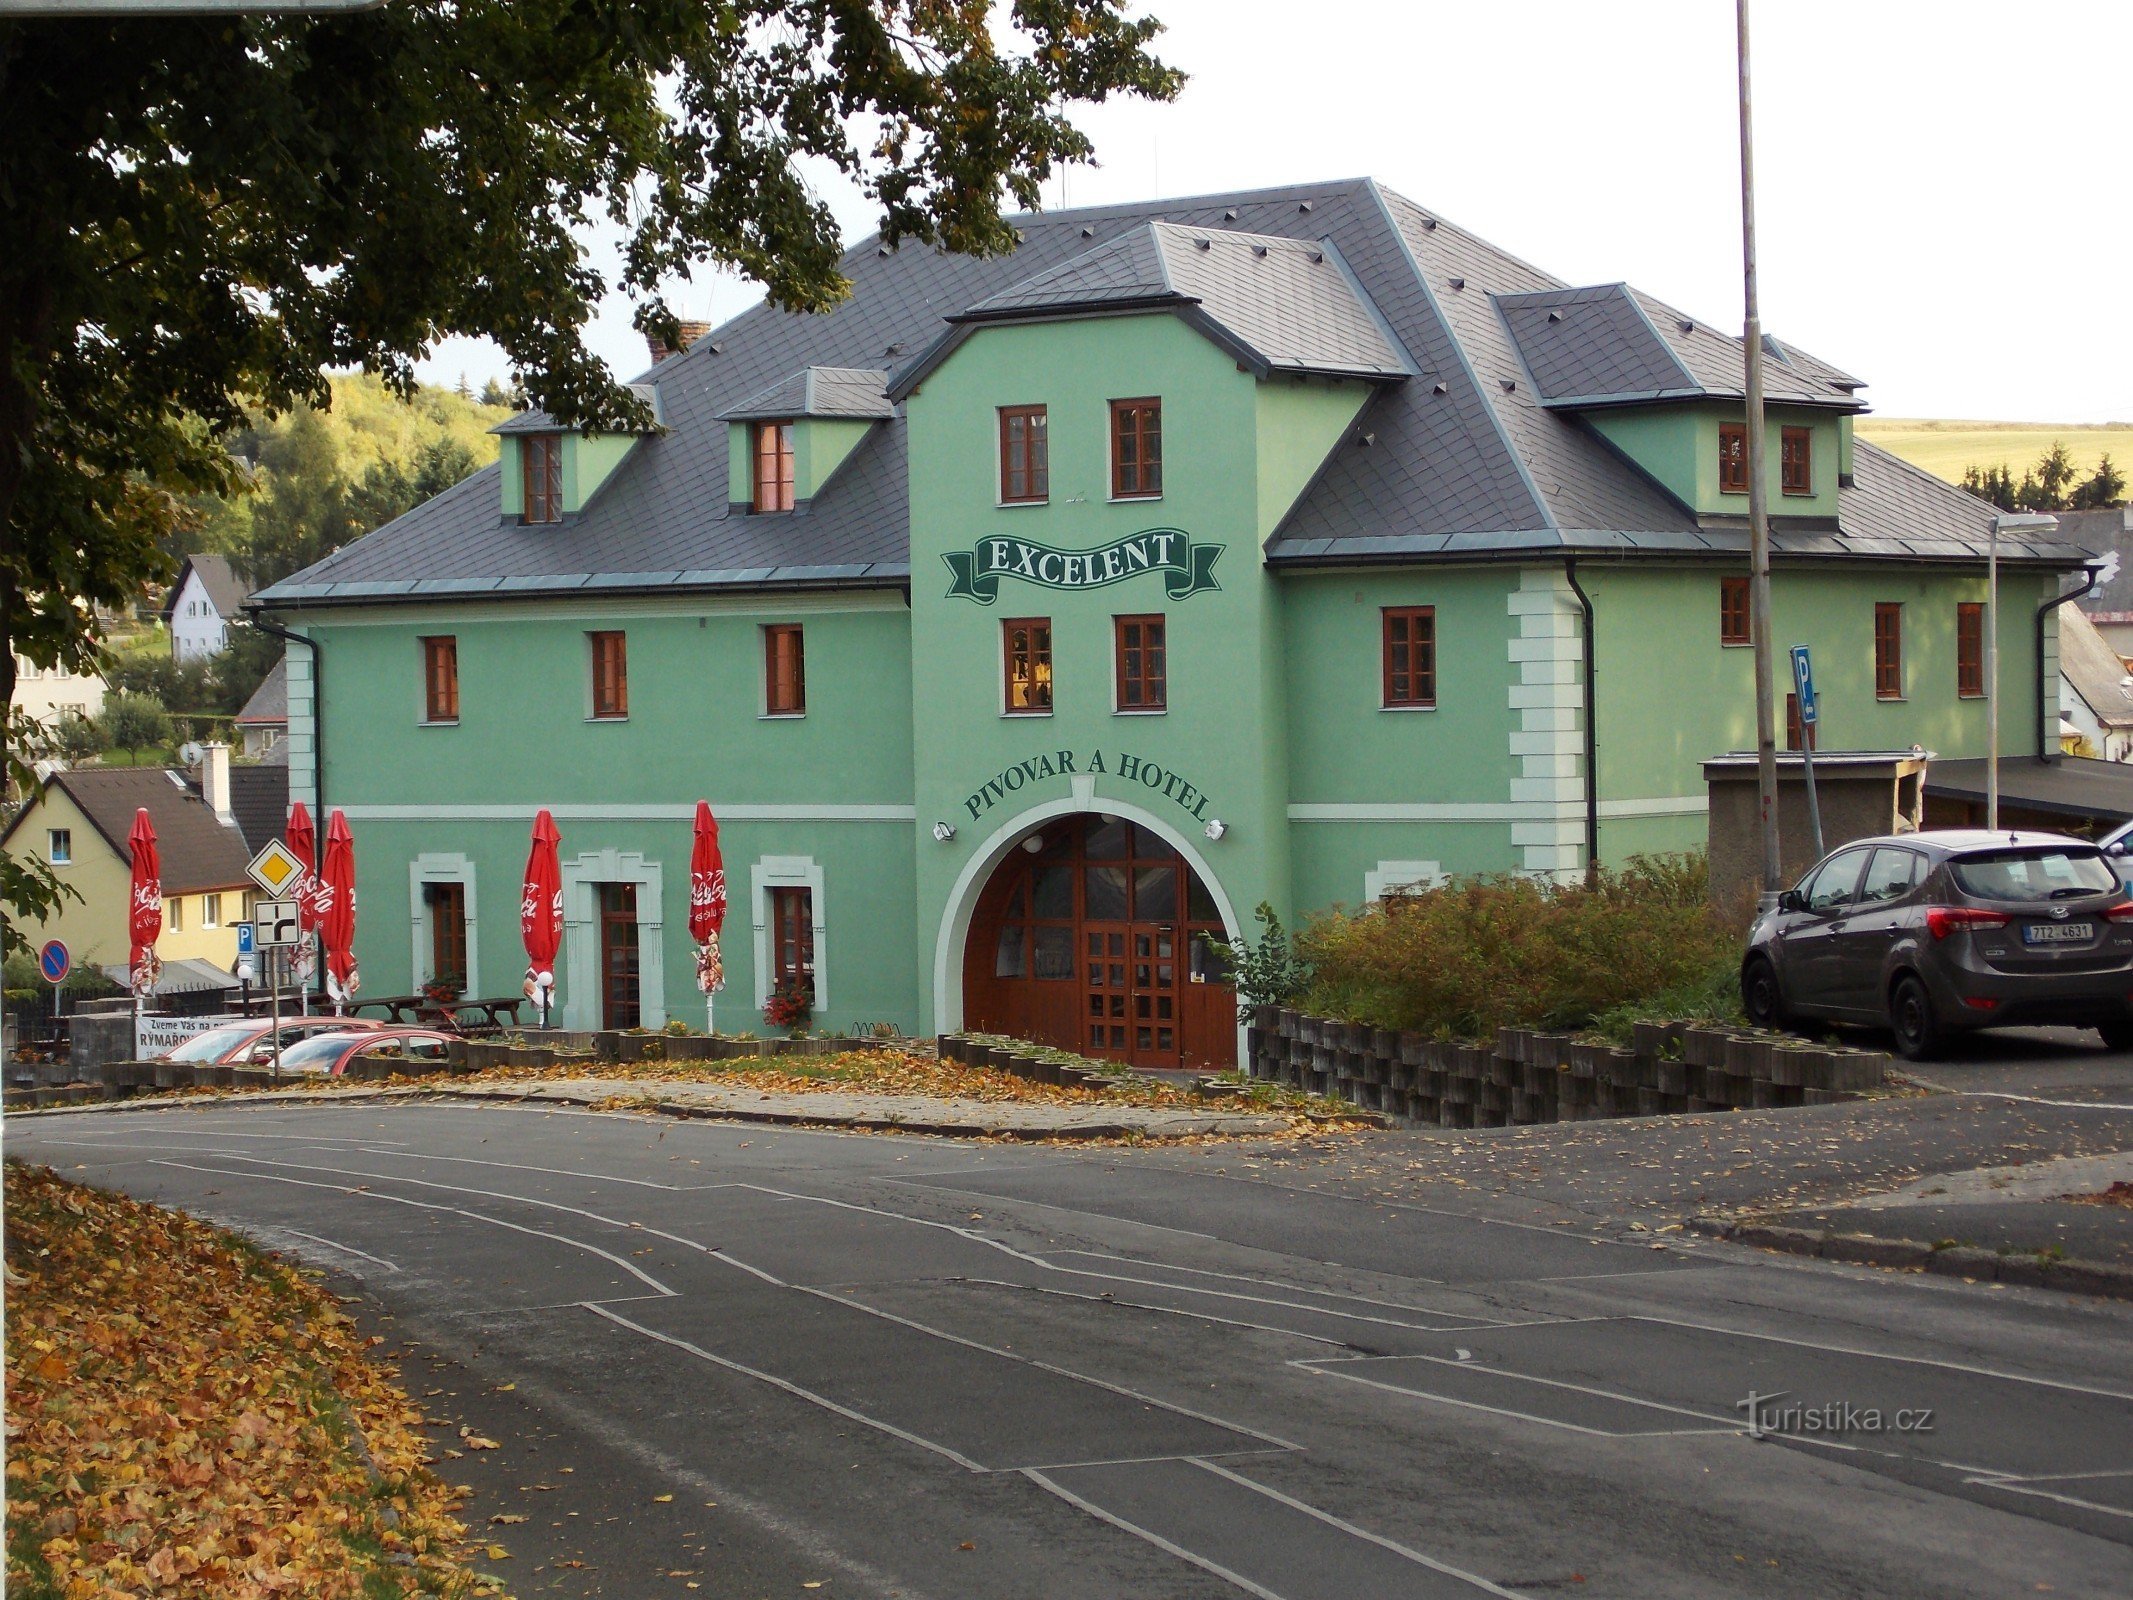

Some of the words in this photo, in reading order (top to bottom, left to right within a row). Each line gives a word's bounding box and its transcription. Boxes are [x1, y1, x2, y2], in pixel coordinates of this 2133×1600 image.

[989, 532, 1174, 585] EXCELENT
[1798, 656, 1808, 698] P
[964, 750, 1076, 821] PIVOVAR
[1087, 748, 1107, 774] A
[1119, 752, 1210, 823] HOTEL
[241, 927, 250, 945] P
[2033, 926, 2054, 938] 7T2
[2062, 925, 2089, 938] 4631
[151, 1019, 178, 1030] Zveme
[180, 1019, 196, 1030] Vás
[199, 1022, 210, 1030] na
